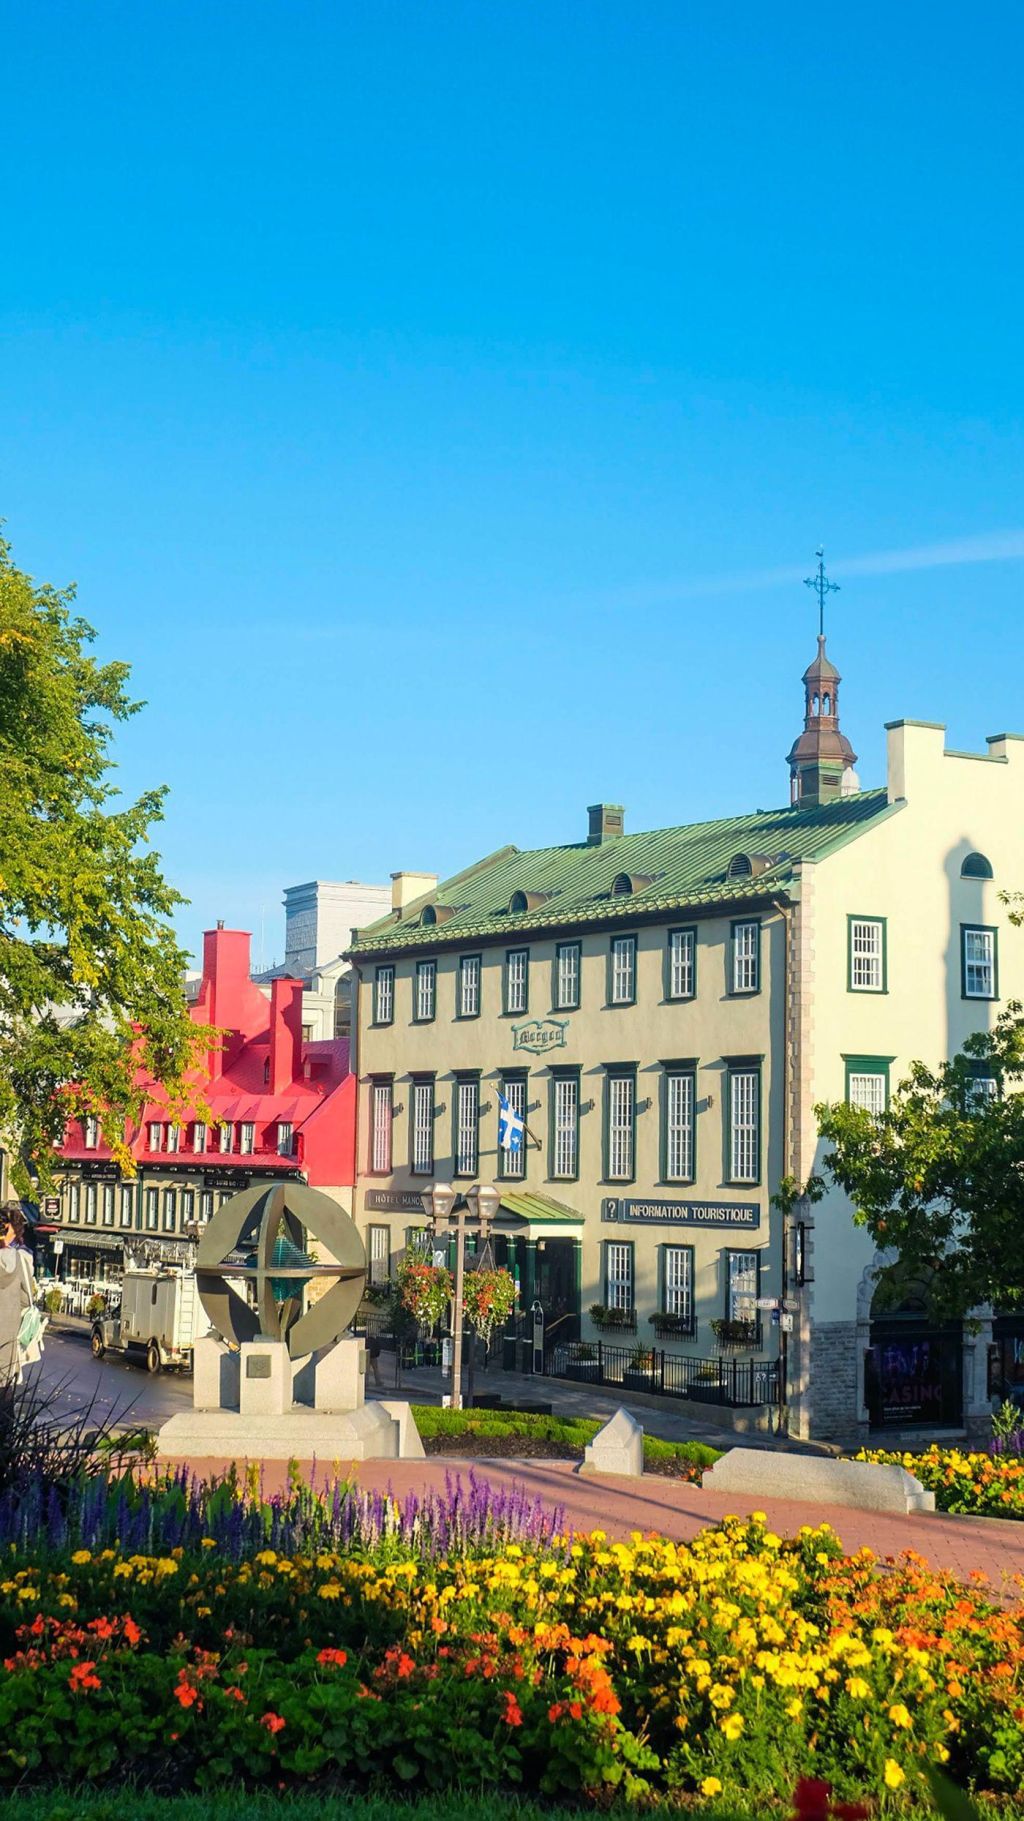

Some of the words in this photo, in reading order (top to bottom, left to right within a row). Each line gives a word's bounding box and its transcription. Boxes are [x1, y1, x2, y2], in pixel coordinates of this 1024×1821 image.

[375, 1193, 399, 1204] HÔTEL
[402, 1195, 422, 1206] MANO
[629, 1204, 688, 1219] INFORMATION
[692, 1207, 753, 1222] TOURISTIQUE
